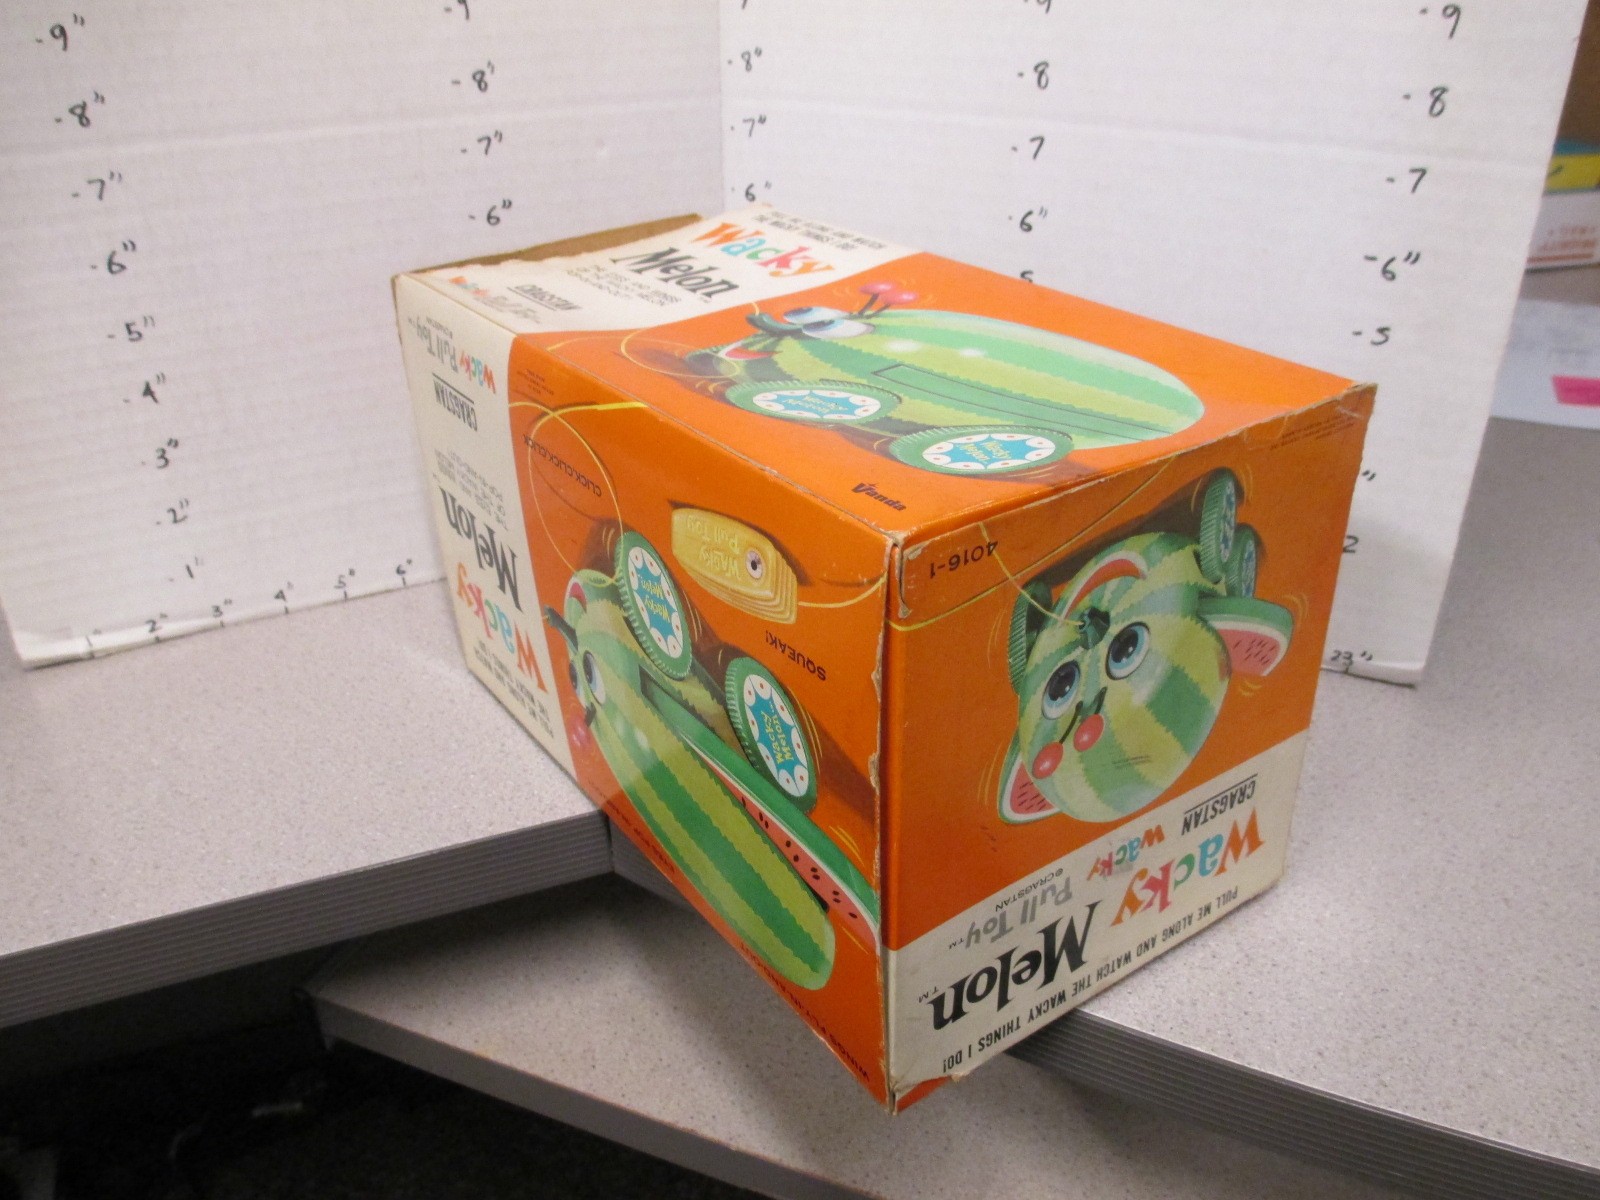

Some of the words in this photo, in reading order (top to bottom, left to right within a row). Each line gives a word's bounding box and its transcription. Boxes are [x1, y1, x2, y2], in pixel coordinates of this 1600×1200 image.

[691, 222, 834, 278] Wacky
[610, 247, 740, 298] Melon
[851, 483, 907, 511] Vanda
[438, 486, 522, 612] Melon
[929, 539, 998, 578] 4016-1
[459, 564, 547, 693] Wacky
[765, 628, 825, 683] SQUEAK!
[1181, 778, 1255, 835] CRAGSTAN
[1110, 806, 1263, 927] Wacky
[1022, 874, 1071, 926] Pull
[1195, 901, 1211, 921] ME
[1214, 885, 1238, 910] PULL
[964, 909, 1012, 951] Toy
[1135, 933, 1157, 957] AND
[1160, 912, 1193, 942] ALONG
[925, 899, 1101, 1032] Melon
[1071, 973, 1091, 997] THE
[1095, 949, 1131, 982] WATCH
[1027, 989, 1064, 1023] WACKY
[977, 1014, 1021, 1052] THINGS
[942, 1048, 962, 1073] DO!
